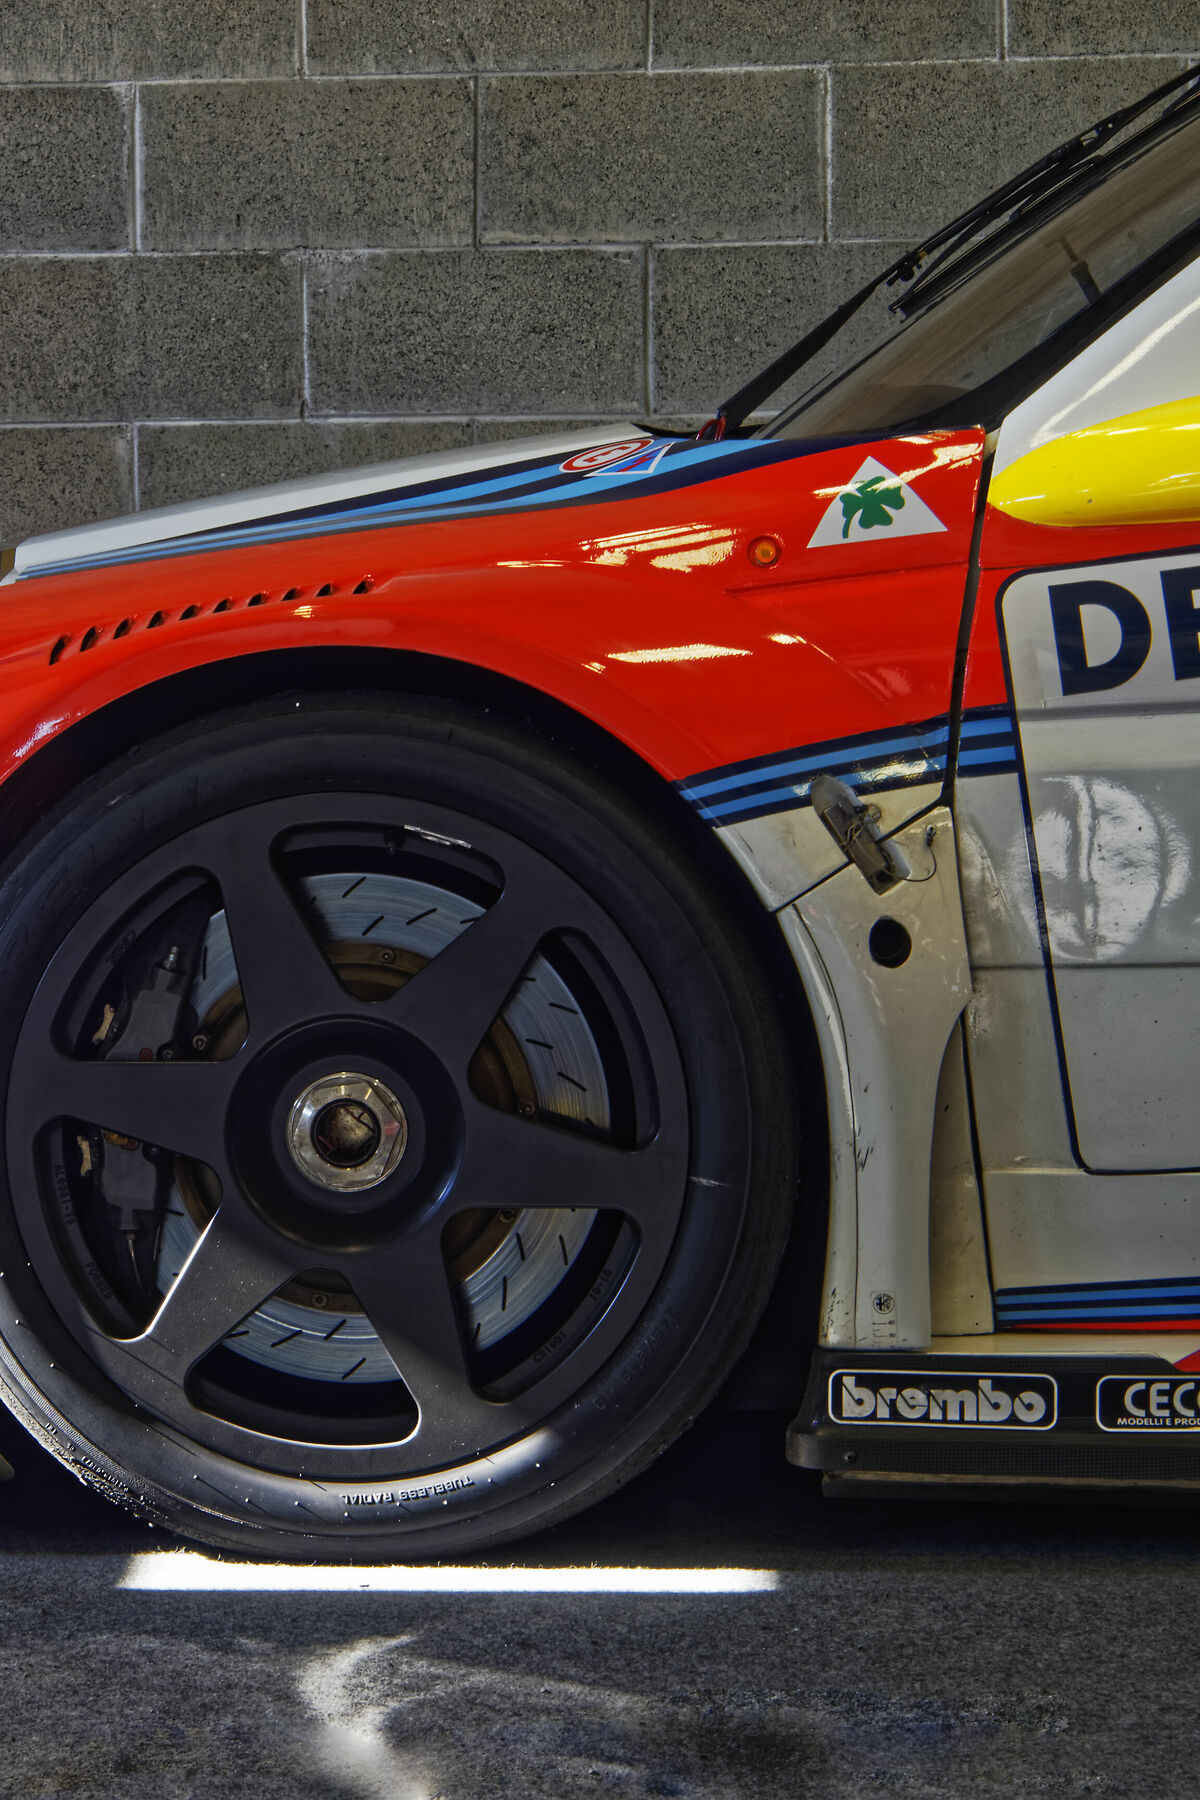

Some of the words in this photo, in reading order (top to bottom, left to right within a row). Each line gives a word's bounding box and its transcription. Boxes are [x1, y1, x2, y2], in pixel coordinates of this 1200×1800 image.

[842, 1375, 1046, 1423] brembo
[1124, 1381, 1200, 1417] CEC
[1117, 1417, 1163, 1426] MODELLI
[1174, 1417, 1200, 1426] PRO
[339, 1492, 395, 1505] RADIAL
[399, 1475, 476, 1502] TUBELESS
